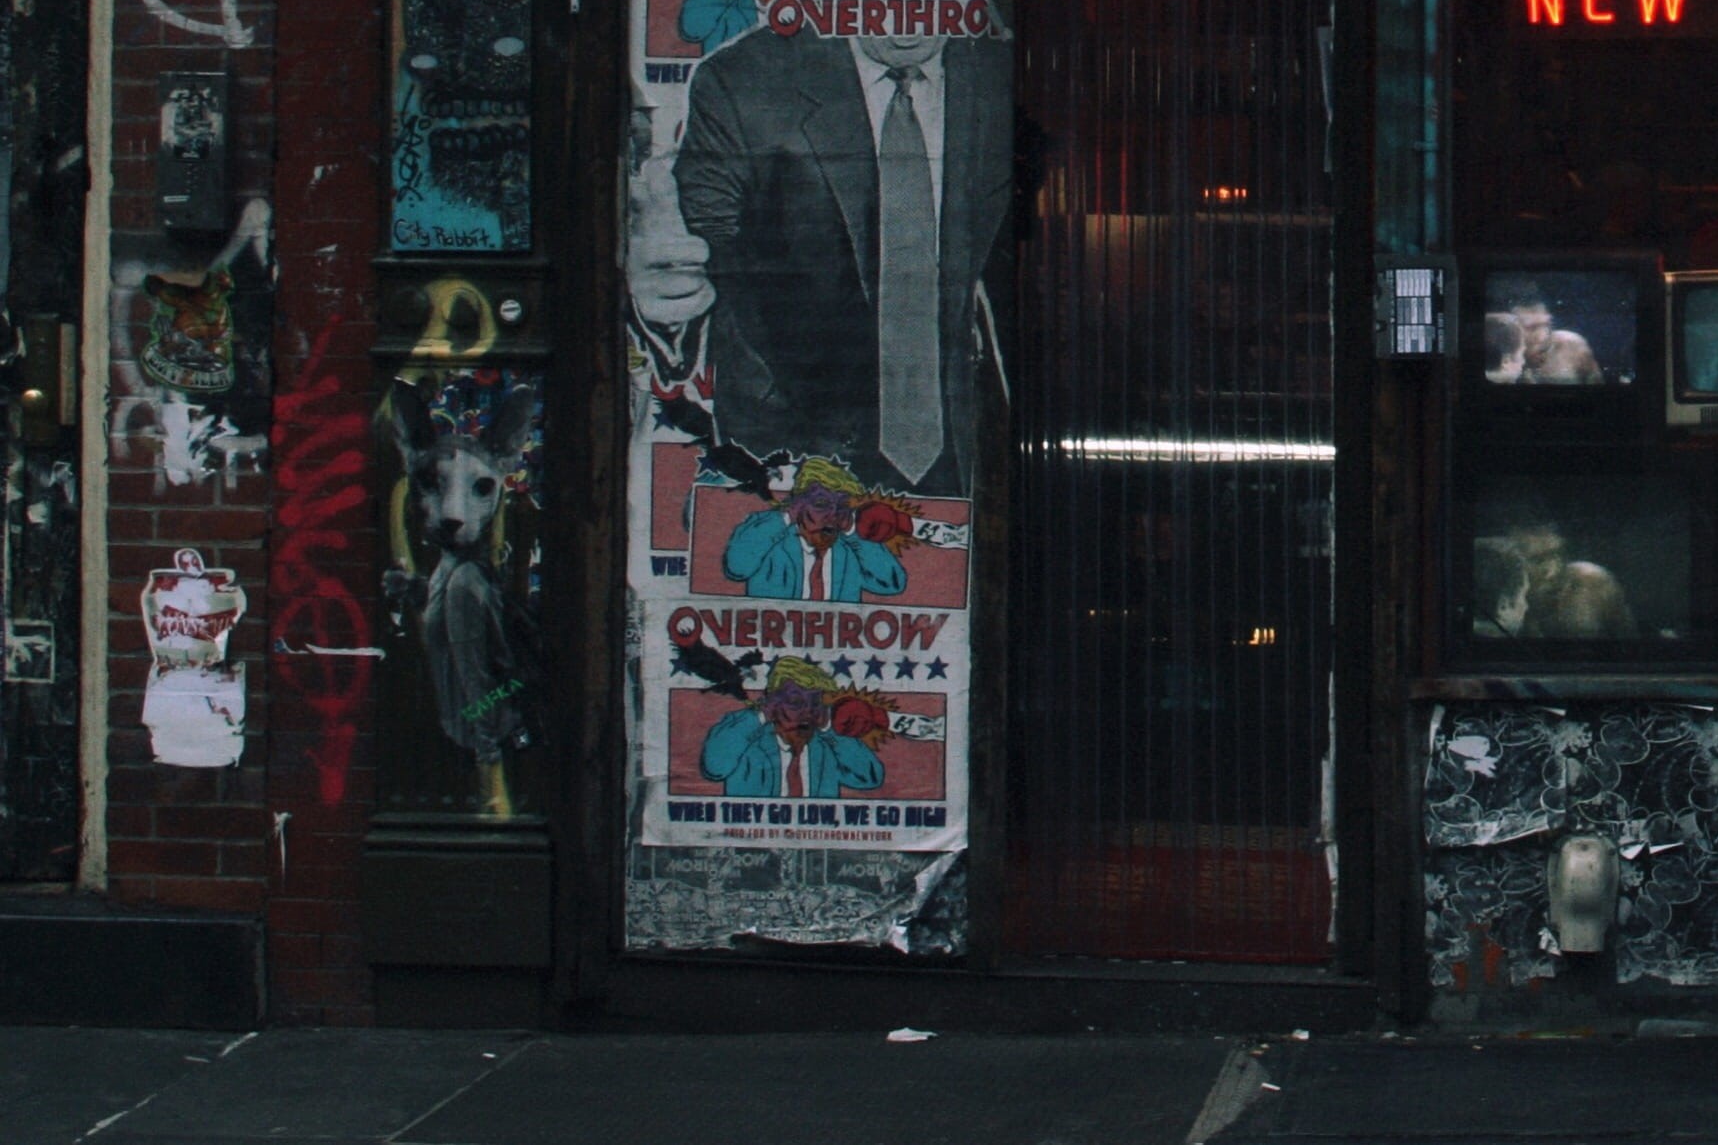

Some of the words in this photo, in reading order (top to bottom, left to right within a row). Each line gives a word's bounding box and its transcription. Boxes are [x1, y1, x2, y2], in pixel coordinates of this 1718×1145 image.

[394, 218, 431, 247] City
[667, 605, 951, 652] OVERTHROW
[668, 801, 716, 823] WHEN
[721, 801, 764, 824] THEY
[768, 803, 792, 825] GO
[798, 804, 840, 828] LOW,
[845, 804, 871, 826] WE
[876, 805, 900, 826] GO
[905, 806, 947, 828] HIGH
